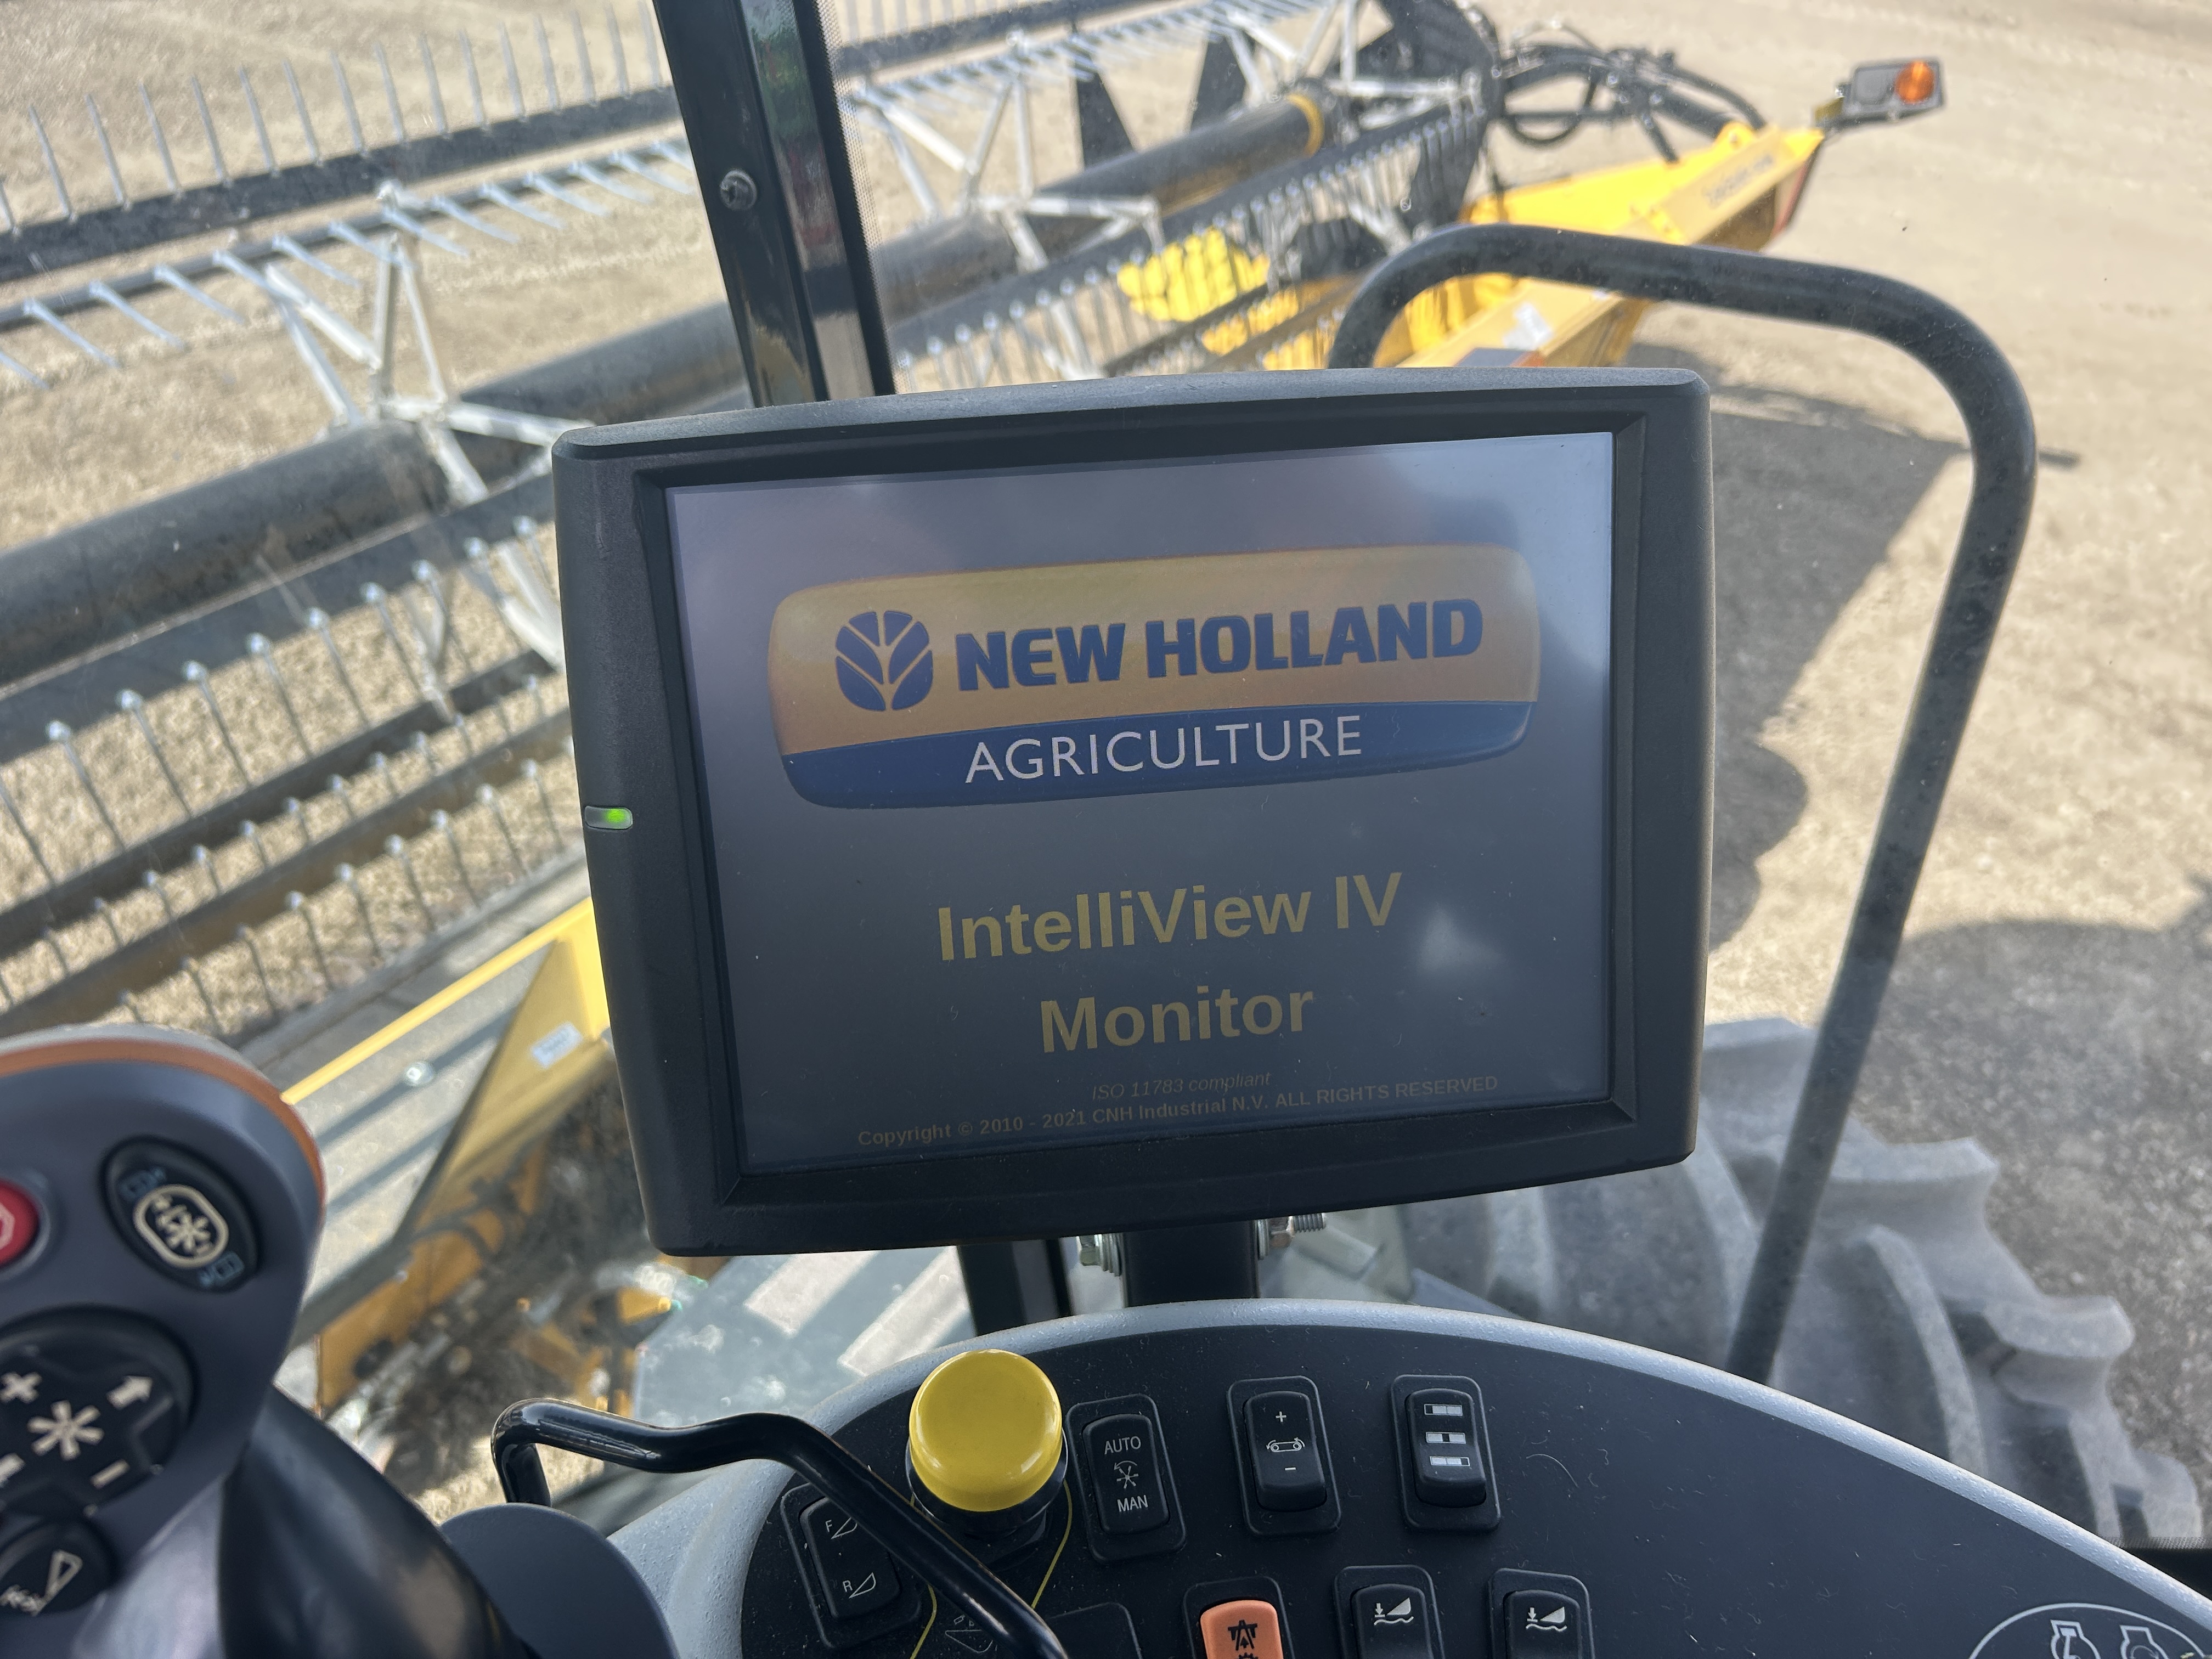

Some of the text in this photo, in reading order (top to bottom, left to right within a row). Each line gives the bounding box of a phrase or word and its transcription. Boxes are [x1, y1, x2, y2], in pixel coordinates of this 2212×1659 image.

[955, 598, 1483, 691] NEW HOLLAND
[965, 714, 1362, 784] AGRICULTURE
[938, 871, 1403, 961] IntelliView IV
[1040, 985, 1314, 1054] Monitor
[1092, 1071, 1272, 1100] ISO 11783 compliant
[857, 1123, 952, 1148] Copyright
[979, 1116, 1024, 1135] 2010
[1042, 1109, 1087, 1128] 2021
[1092, 1105, 1133, 1124] CNH
[1139, 1098, 1227, 1120] Industrial
[1232, 1095, 1268, 1111] N.V.
[1275, 1092, 1311, 1109] ALL
[1317, 1085, 1390, 1104] RIGHTS
[1395, 1075, 1498, 1098] RESERVED
[1103, 1435, 1142, 1455] AUTO
[825, 1519, 833, 1533] F
[1116, 1494, 1149, 1513] MAN
[842, 1579, 854, 1593] R
